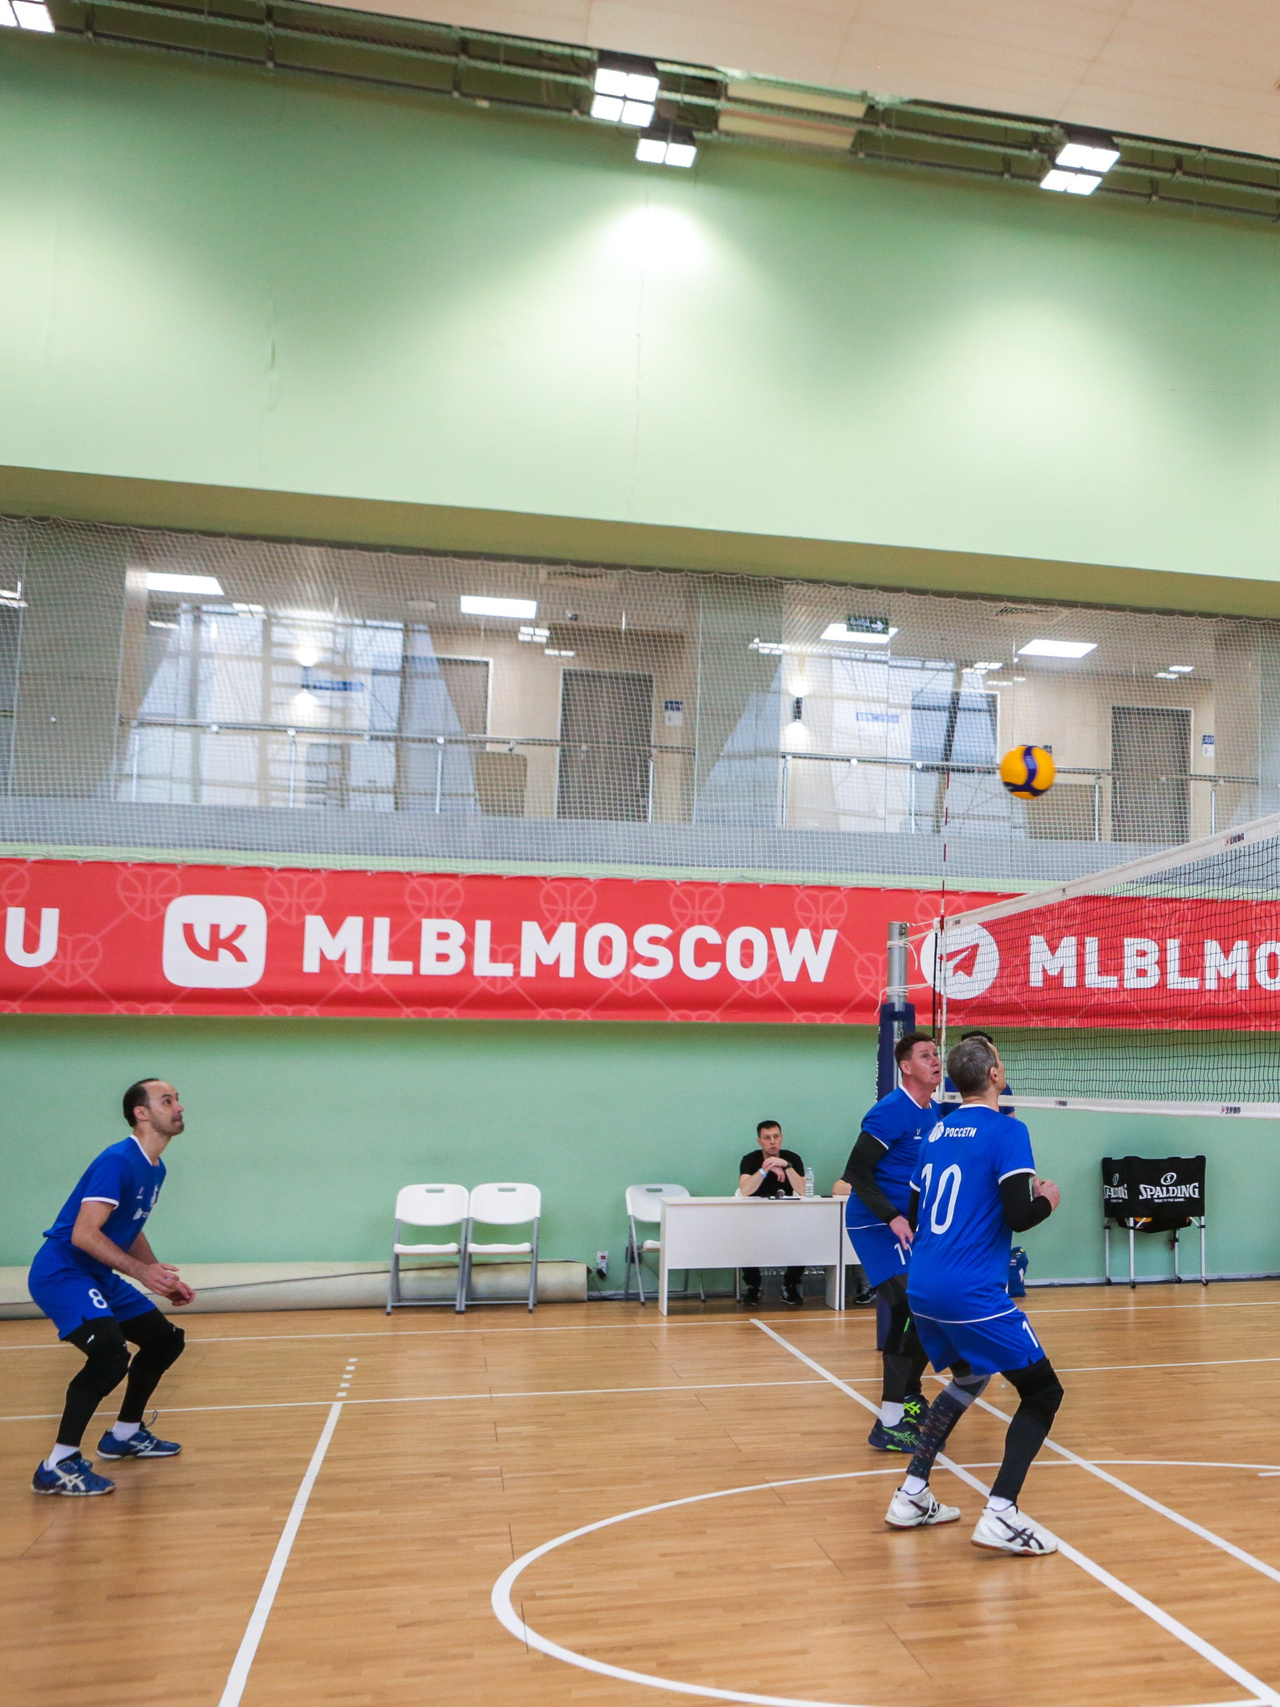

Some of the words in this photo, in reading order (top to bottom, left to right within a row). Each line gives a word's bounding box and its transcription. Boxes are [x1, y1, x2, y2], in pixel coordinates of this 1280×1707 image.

[5, 907, 60, 968] U
[302, 914, 838, 983] MLBLMOSCOW
[944, 1126, 977, 1138] РОССЕТИ
[920, 1163, 962, 1235] 10
[1138, 1182, 1200, 1200] SPALDING
[88, 1288, 108, 1309] 8
